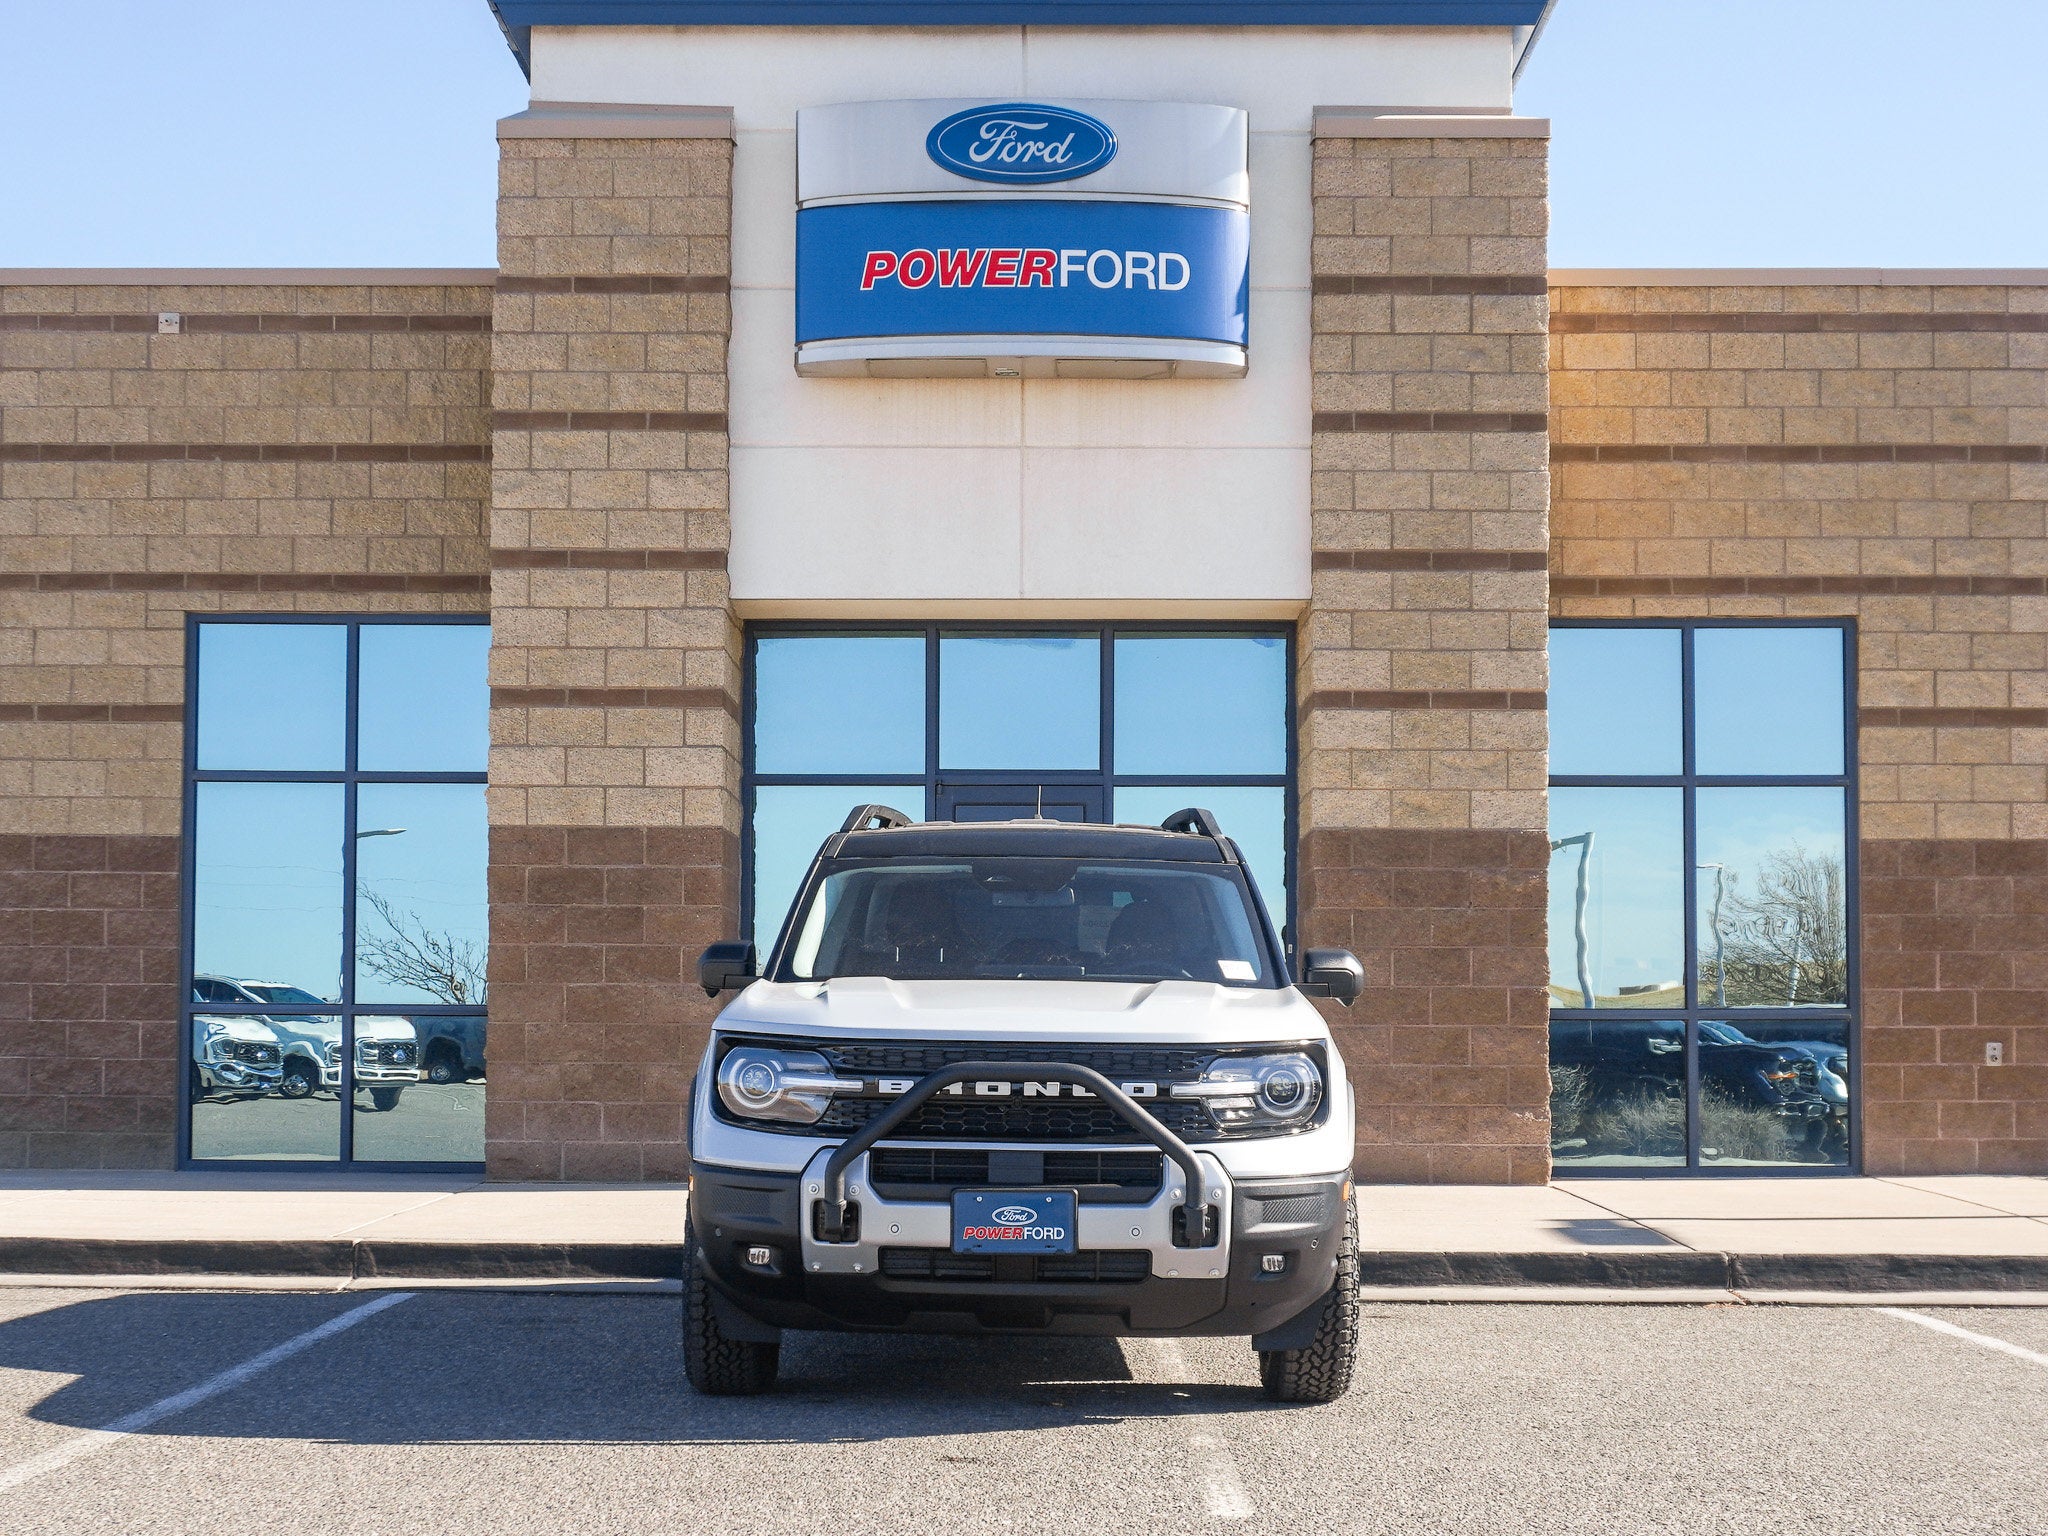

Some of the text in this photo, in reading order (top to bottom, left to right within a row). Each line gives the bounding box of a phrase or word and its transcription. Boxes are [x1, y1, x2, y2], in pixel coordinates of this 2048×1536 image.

[969, 119, 1075, 164] Ford
[860, 248, 1191, 291] POWERFORD
[1001, 1209, 1028, 1221] Ford
[963, 1226, 1065, 1240] POWERFORD
